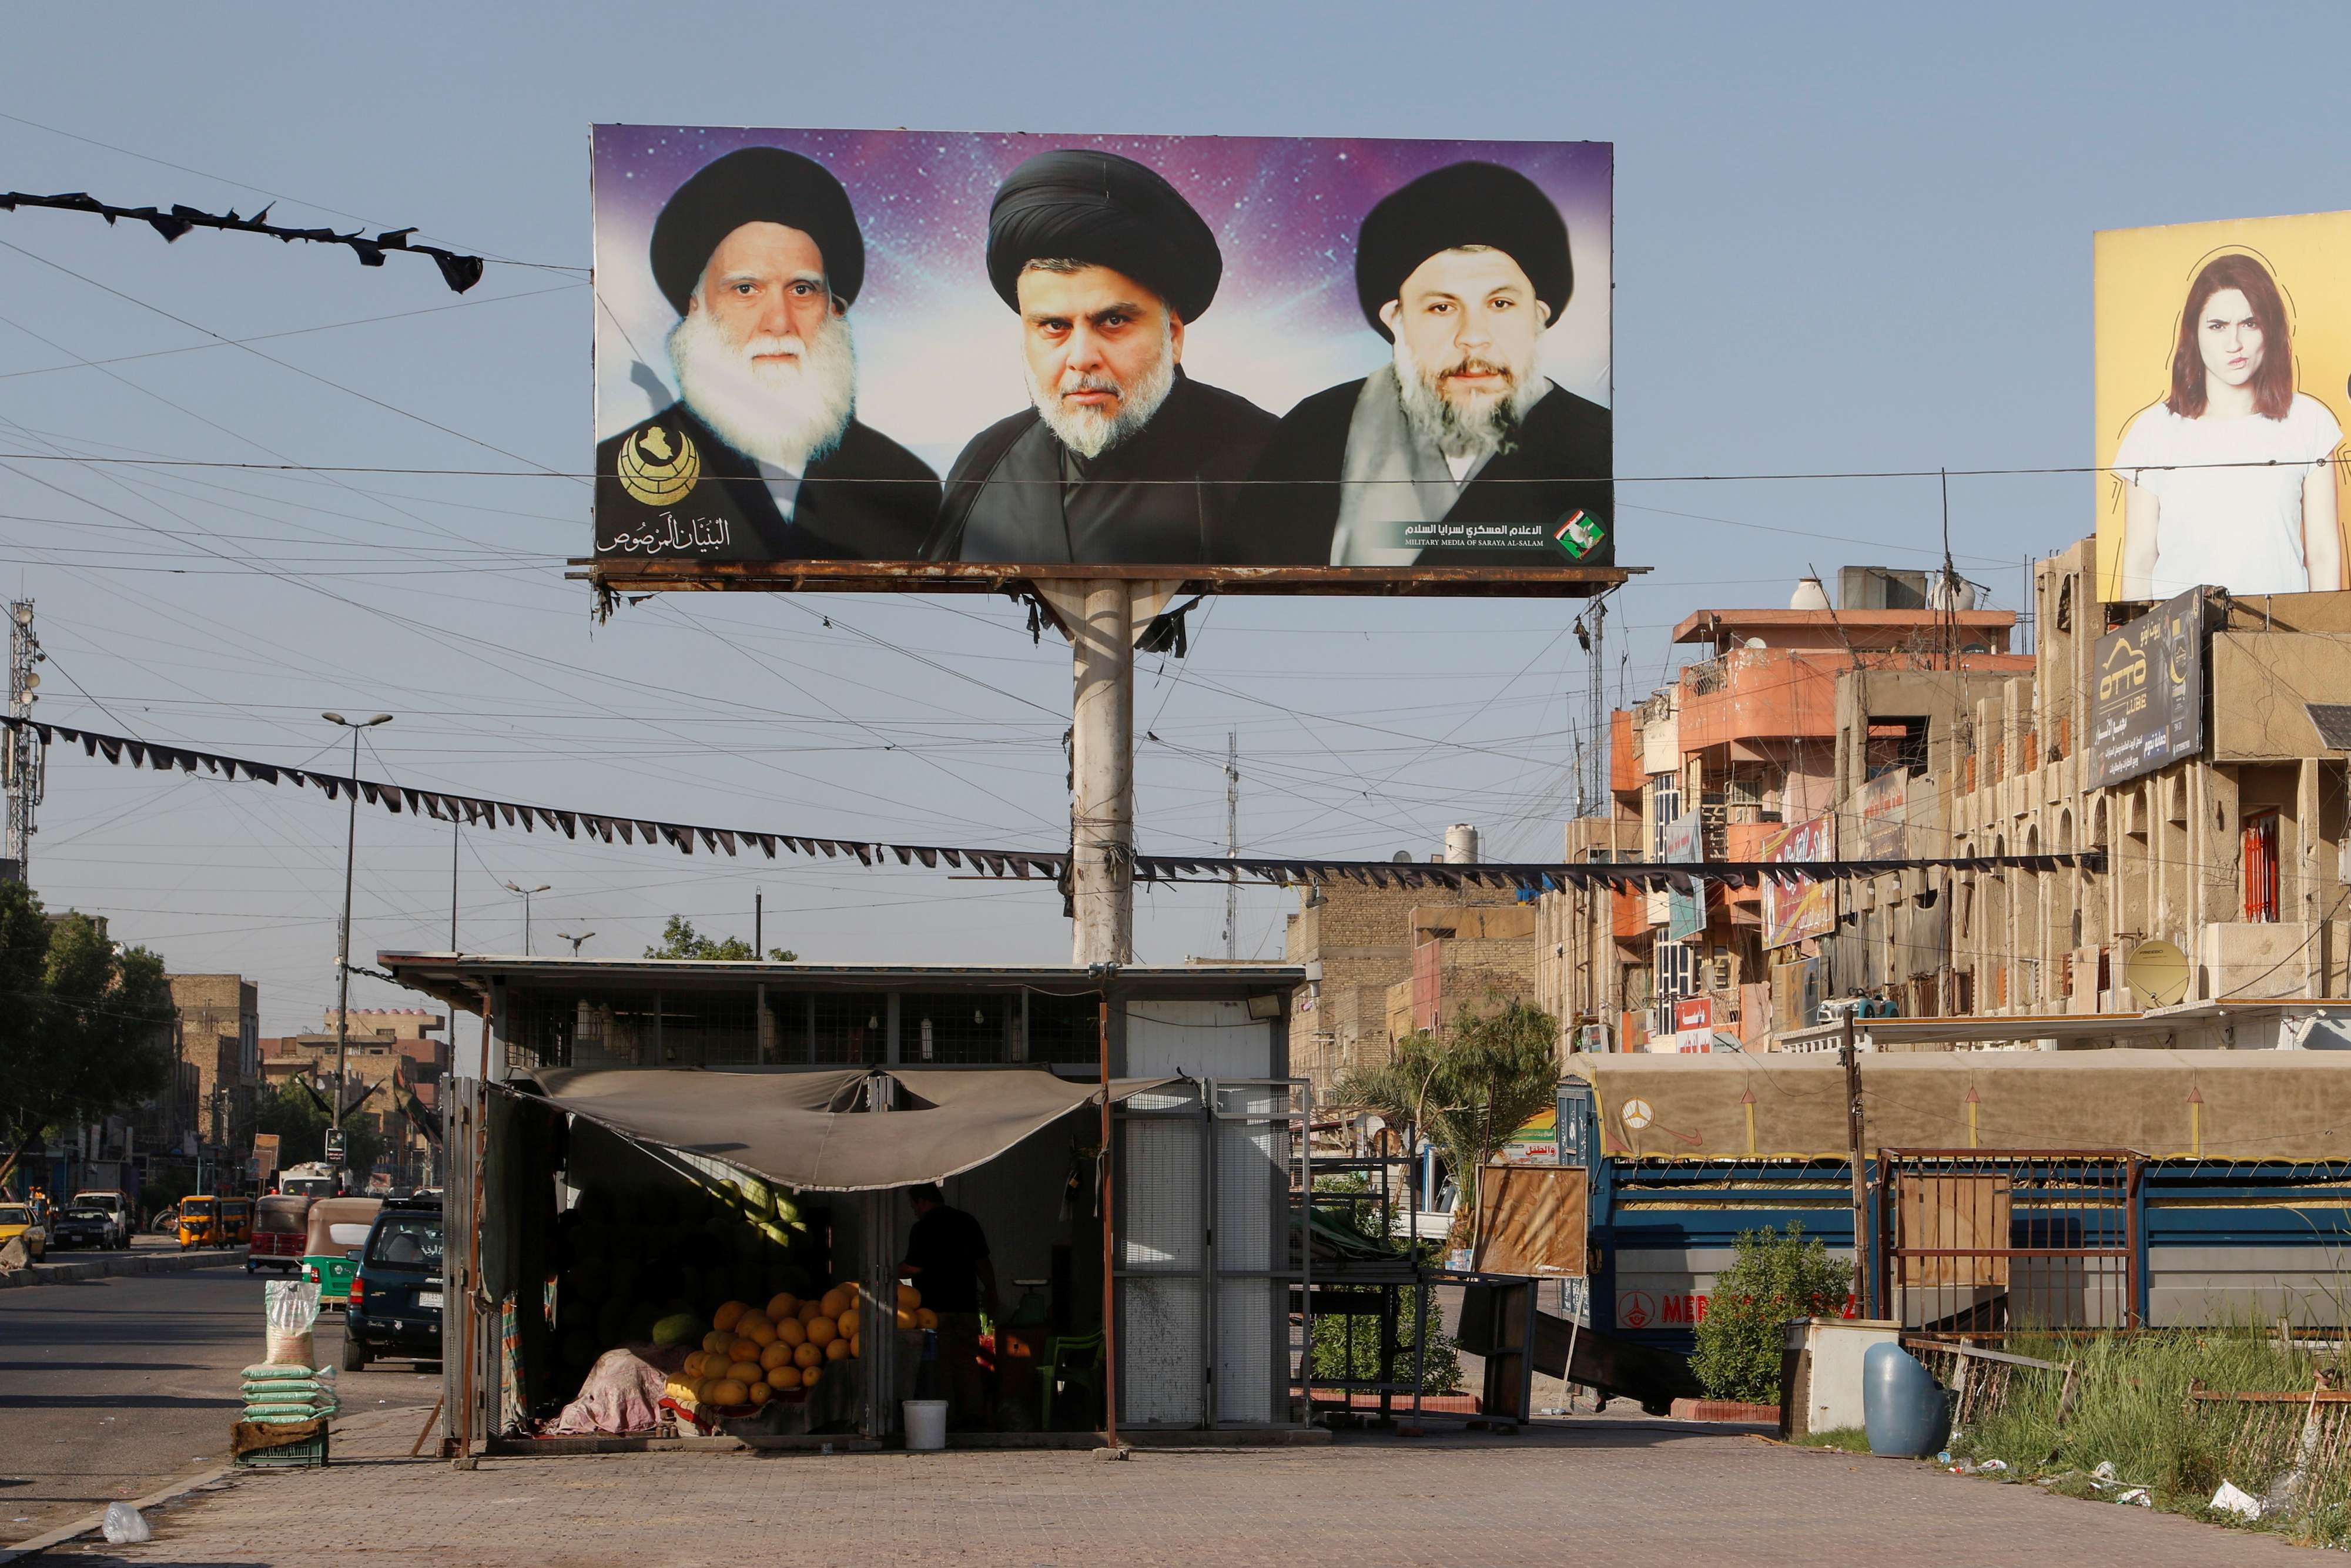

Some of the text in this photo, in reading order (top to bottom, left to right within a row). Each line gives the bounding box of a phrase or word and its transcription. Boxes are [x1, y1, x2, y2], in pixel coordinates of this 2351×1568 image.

[1405, 524, 1542, 538] الاعلام العسكري لسرايا السلام
[1405, 538, 1544, 547] MILITARY MEDIA OF SARAYA AL-SALAM
[2149, 617, 2161, 642] زيوت
[2099, 658, 2146, 702] OTTO
[2126, 693, 2147, 716] LUBE
[1525, 1145, 1556, 1157] والطفل
